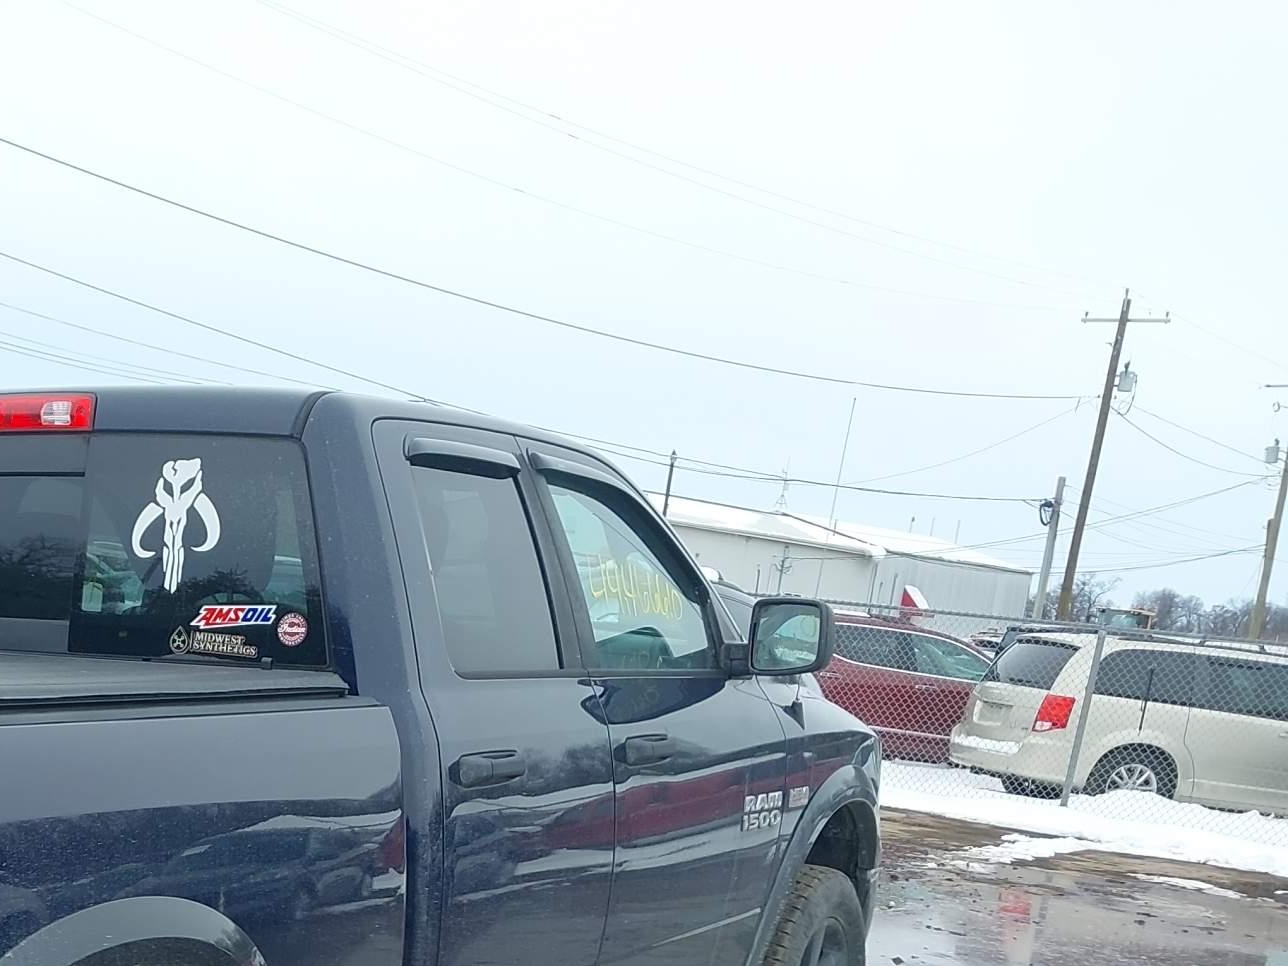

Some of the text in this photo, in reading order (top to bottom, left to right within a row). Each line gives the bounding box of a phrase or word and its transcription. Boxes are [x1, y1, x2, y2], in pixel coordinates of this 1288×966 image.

[192, 605, 277, 628] AMSOIL
[192, 640, 257, 657] SYNTHETICS
[194, 631, 245, 646] MIDWEST
[744, 791, 783, 812] RAM
[743, 809, 782, 830] 1500
